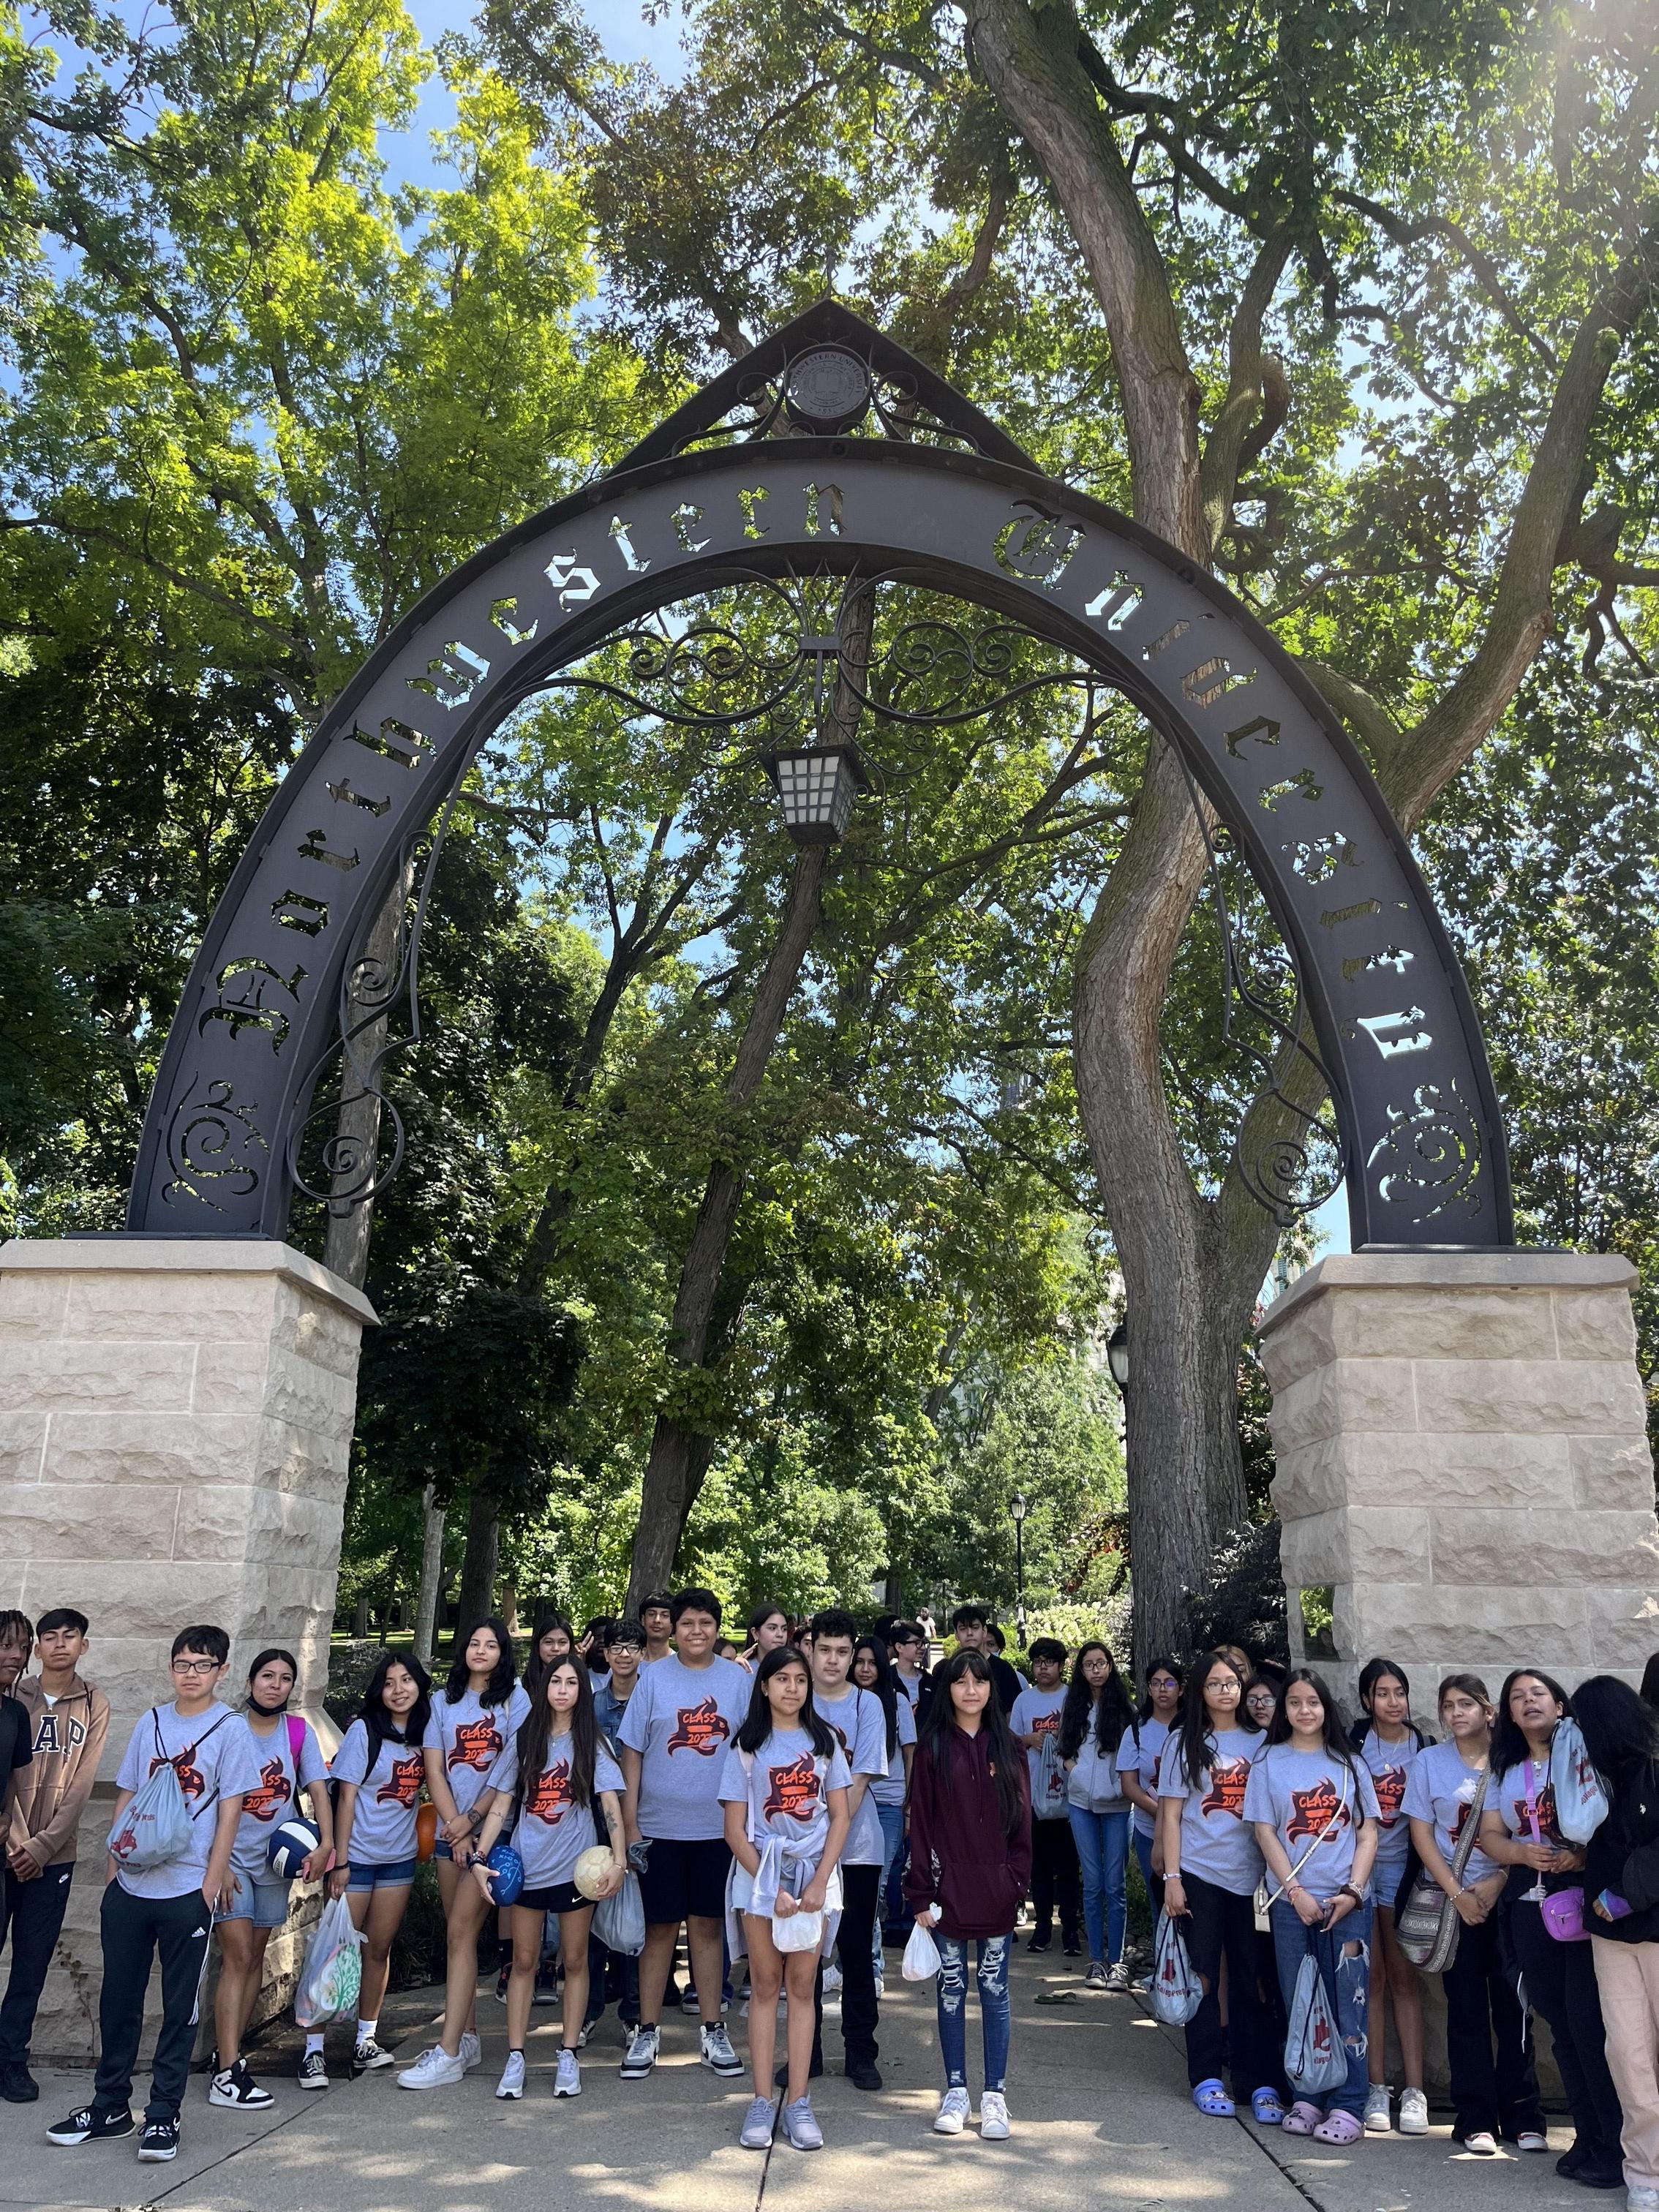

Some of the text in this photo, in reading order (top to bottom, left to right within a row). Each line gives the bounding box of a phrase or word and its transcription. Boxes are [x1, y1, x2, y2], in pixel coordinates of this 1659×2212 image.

[199, 481, 1433, 1059] Northwestern University
[682, 1711, 717, 1724] CLASS
[1035, 1720, 1060, 1729] CLASS
[31, 1715, 87, 1756] AP
[460, 1727, 493, 1739] CLASS
[534, 1776, 566, 1789] LASS
[775, 1770, 813, 1785] CLASS
[1216, 1773, 1247, 1785] CLAS
[1222, 1796, 1244, 1807] 202
[1298, 1794, 1336, 1807] CLASS
